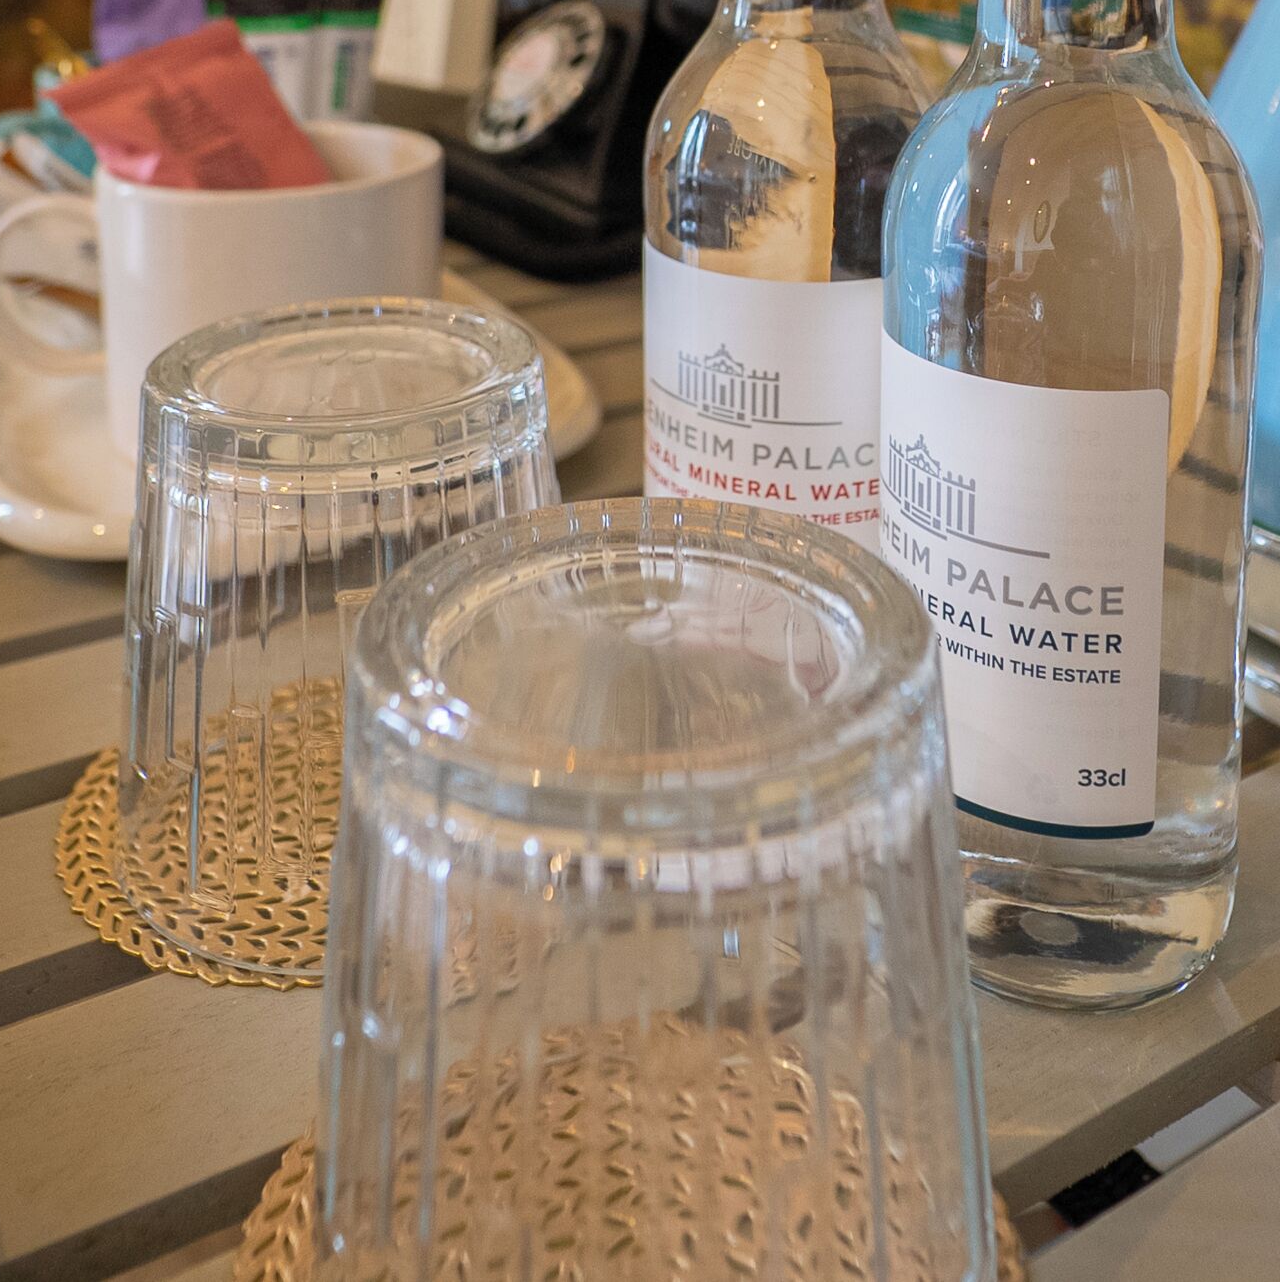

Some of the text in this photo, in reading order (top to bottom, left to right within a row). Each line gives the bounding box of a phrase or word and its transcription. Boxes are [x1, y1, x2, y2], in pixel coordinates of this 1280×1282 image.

[753, 443, 875, 469] PALAC
[689, 462, 797, 501] MINERAL
[810, 478, 880, 501] WATE
[811, 513, 841, 526] THE
[845, 508, 880, 524] ESTA
[882, 507, 931, 576] HEIM
[947, 557, 1125, 616] PALACE
[1009, 623, 1123, 654] WATER
[945, 637, 1005, 671] WITHIN
[1010, 659, 1047, 680] THE
[1052, 667, 1122, 685] ESTATE
[1078, 768, 1126, 787] 33cl
